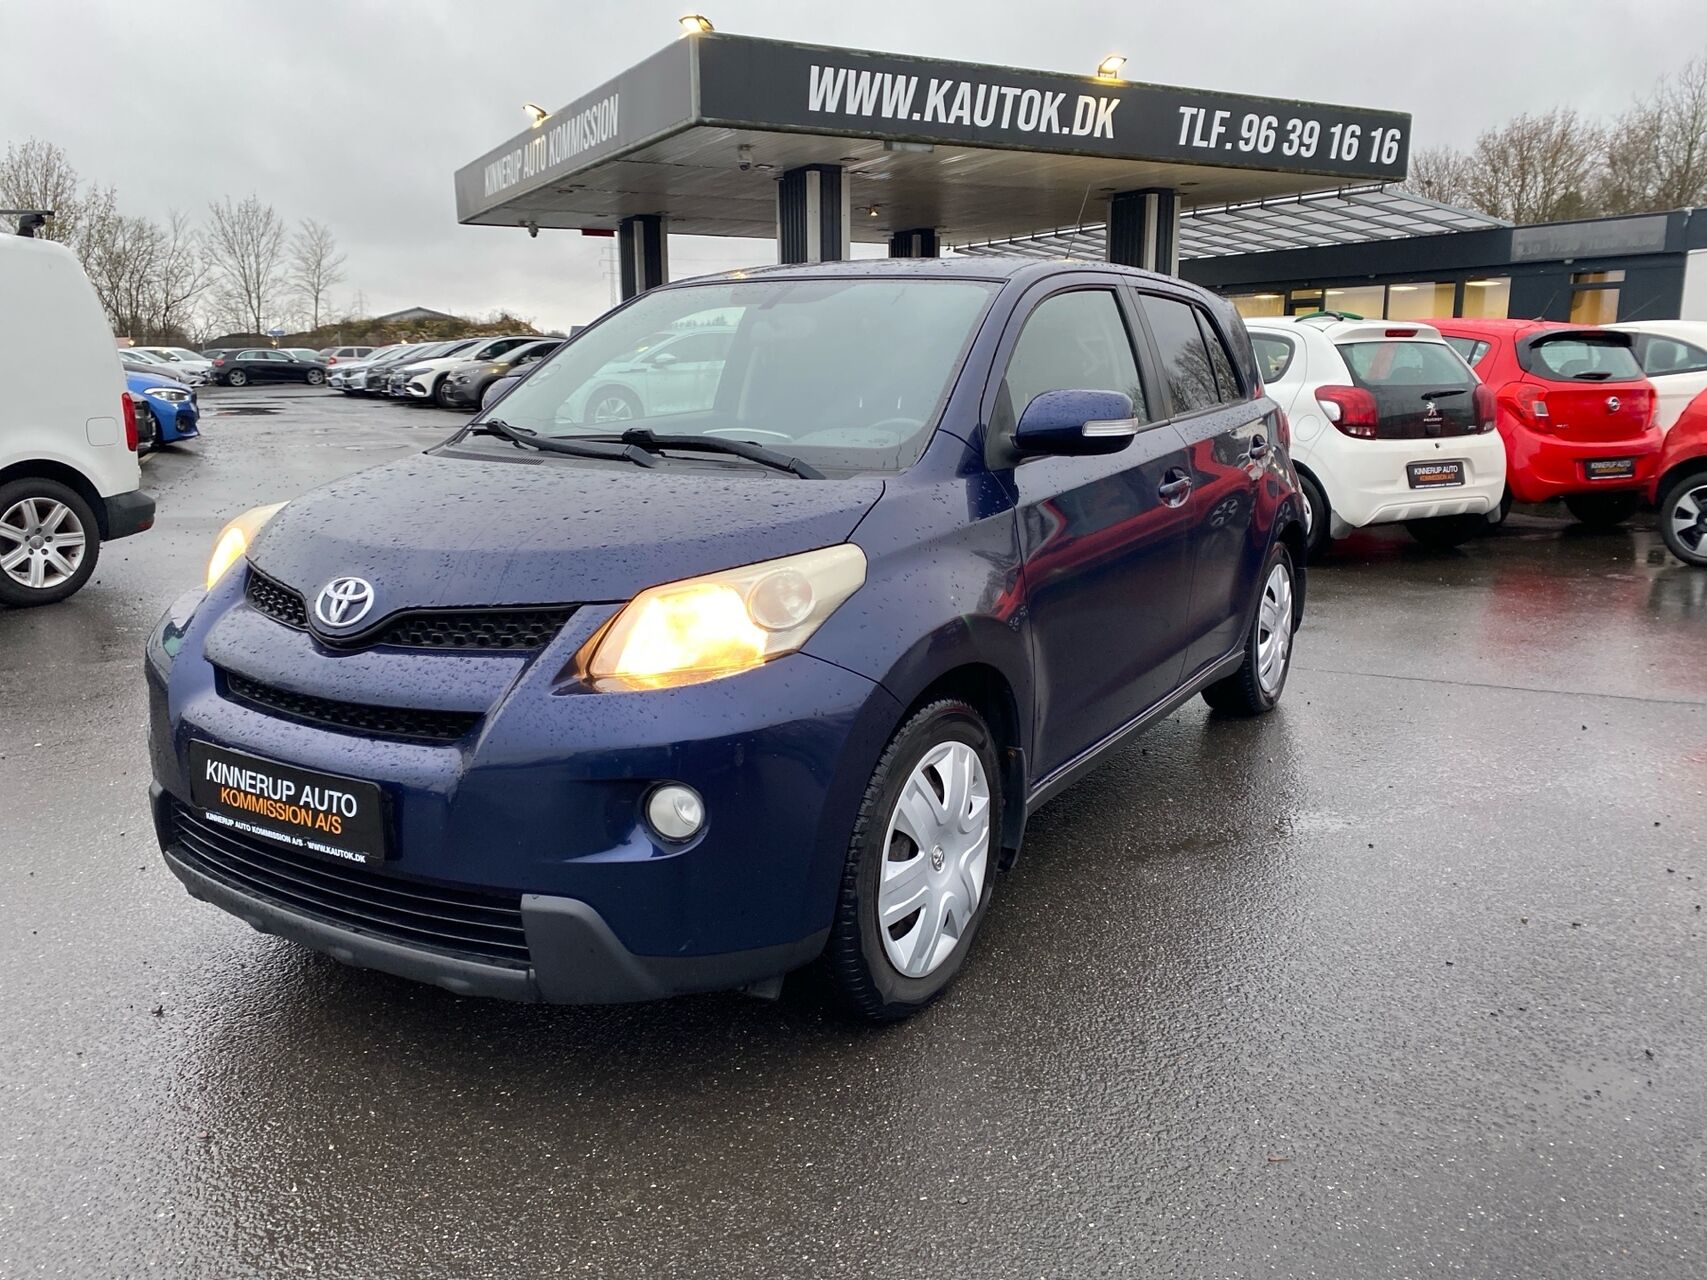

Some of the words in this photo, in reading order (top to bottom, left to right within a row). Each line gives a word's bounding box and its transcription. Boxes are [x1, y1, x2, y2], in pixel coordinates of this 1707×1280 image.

[808, 65, 1121, 139] WWW.KAUTOK.DK
[484, 148, 522, 198] KINNERUP
[523, 134, 547, 179] AUTO
[548, 93, 619, 168] KOMMISSION
[1178, 106, 1233, 150] TLF.
[1238, 113, 1279, 154] 96
[1282, 118, 1321, 158] 39
[1329, 123, 1362, 161] 16
[1370, 127, 1401, 165] 16
[1414, 466, 1442, 475] KINNERUP
[1442, 465, 1458, 473] AUTO
[205, 759, 295, 802] KINNERUP
[300, 785, 358, 818] AUTO
[220, 787, 313, 827] KOMMISSION
[315, 814, 342, 835] A/S
[205, 812, 235, 826] KINNERUP
[235, 821, 251, 832] AUTO
[251, 826, 291, 844] KOMMISSION
[291, 837, 303, 847] A/S
[307, 841, 366, 864] WWW.KAUTOK.DK
